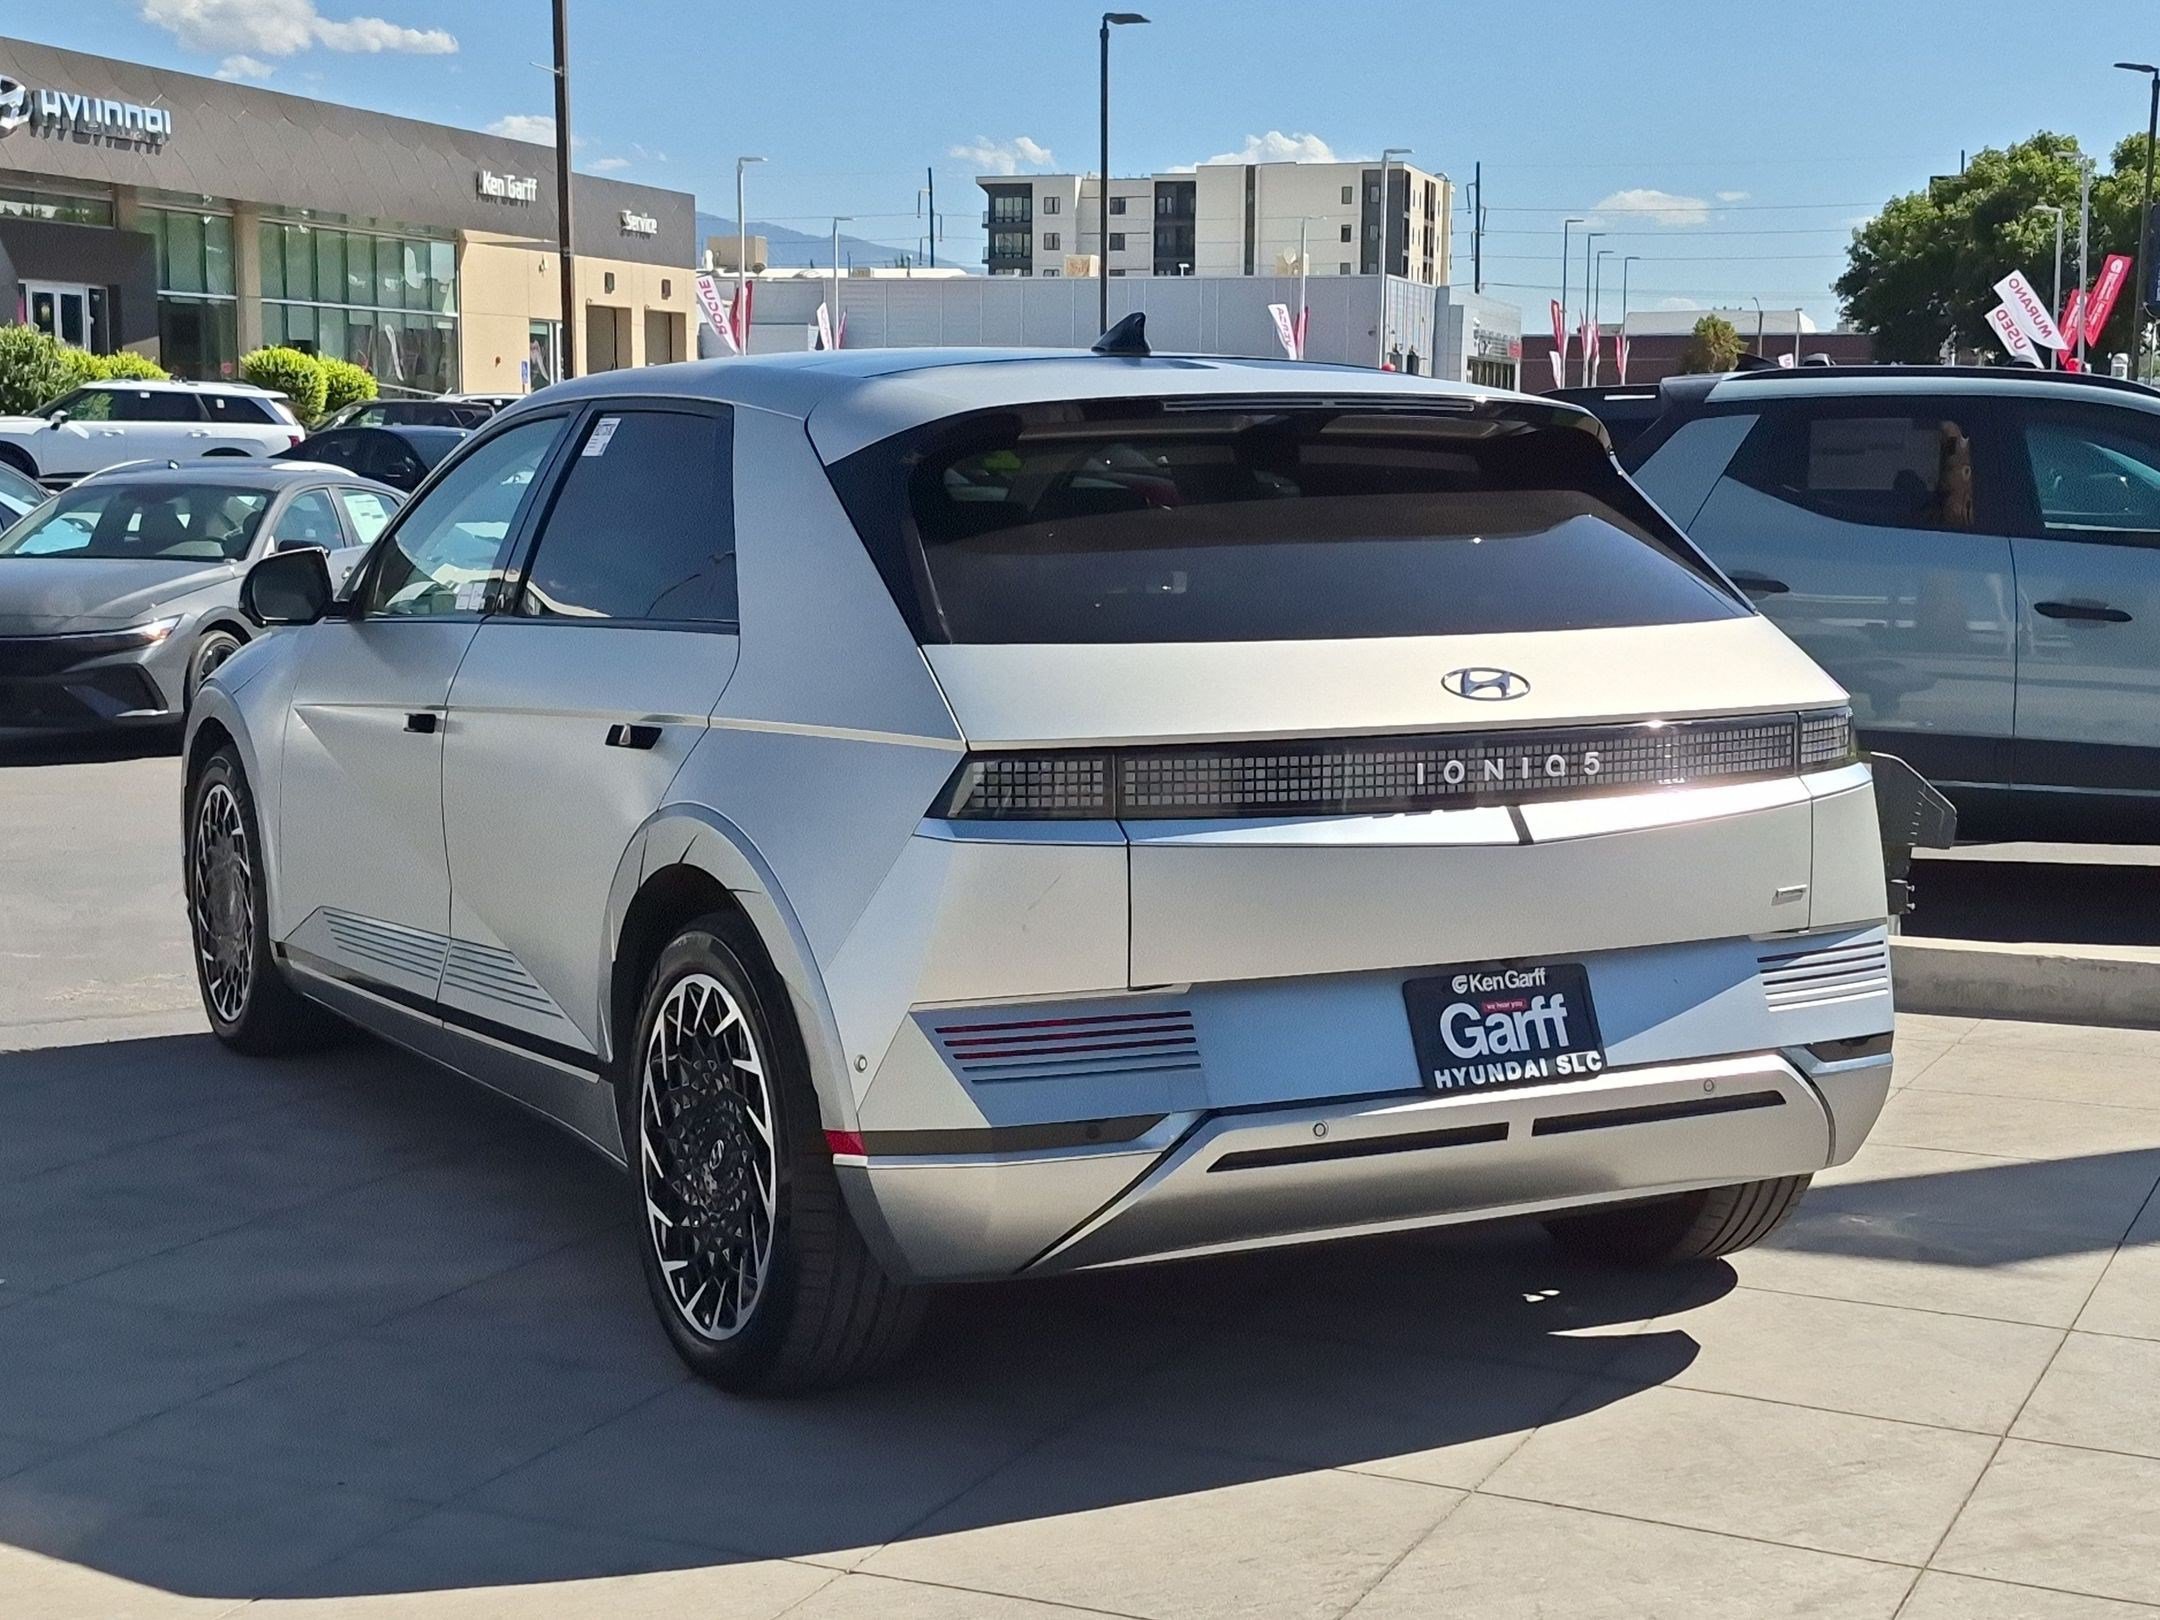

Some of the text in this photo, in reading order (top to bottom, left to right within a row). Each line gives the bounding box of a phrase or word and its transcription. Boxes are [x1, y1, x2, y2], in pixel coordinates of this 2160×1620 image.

[482, 170, 538, 201] Ken Garff
[621, 209, 658, 234] Service
[1416, 751, 1601, 786] IONIQ 5
[1439, 993, 1571, 1060] Garff
[1433, 1050, 1602, 1090] HYUNDAI SLC
